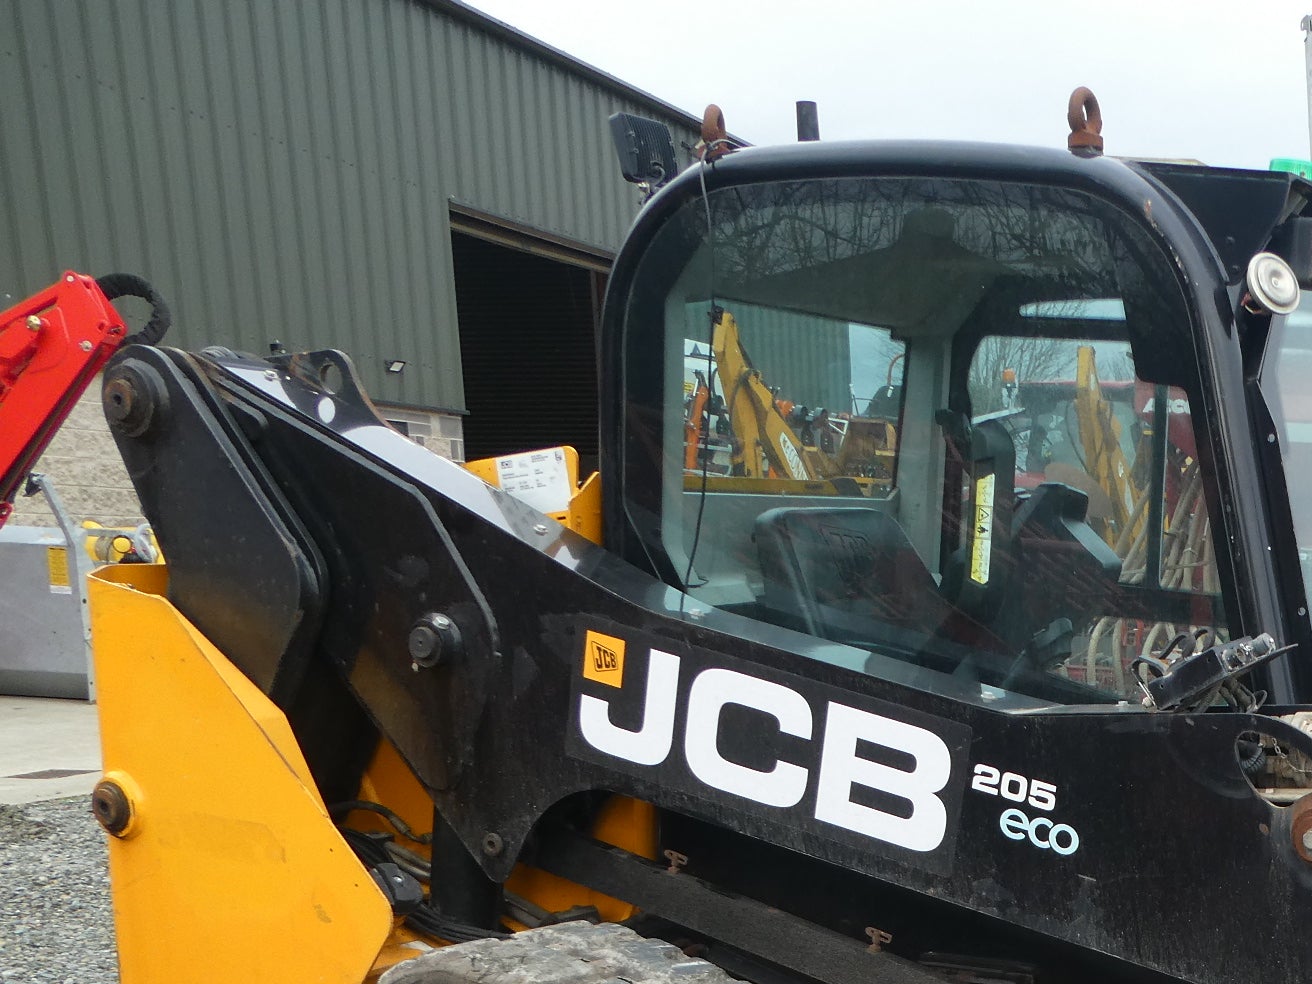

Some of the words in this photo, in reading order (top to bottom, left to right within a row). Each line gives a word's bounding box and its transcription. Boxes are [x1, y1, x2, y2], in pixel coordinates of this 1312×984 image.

[596, 645, 617, 669] JCB
[579, 648, 951, 852] JCB
[972, 763, 1057, 811] 205
[1000, 808, 1079, 855] eco
